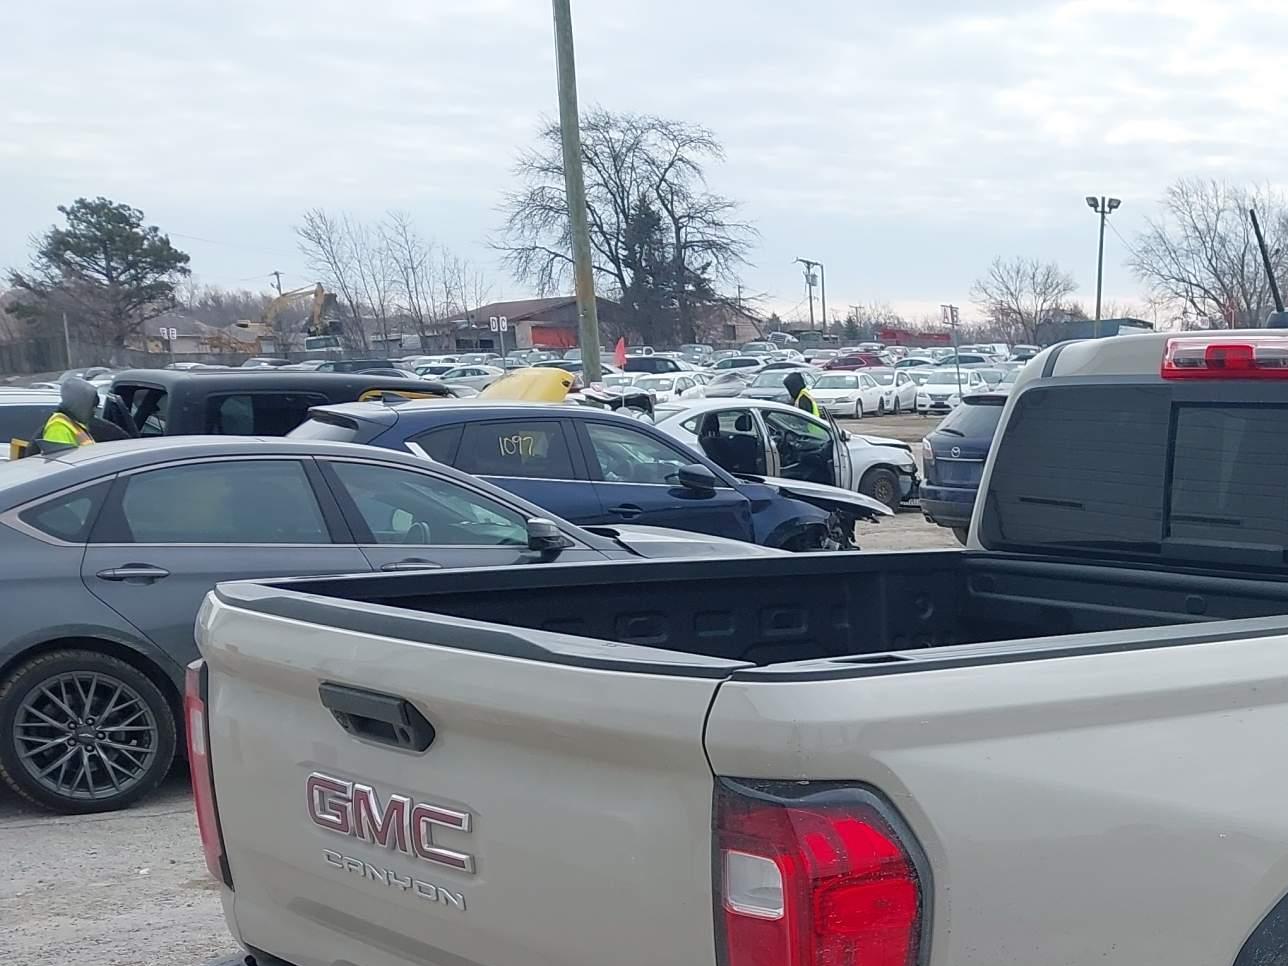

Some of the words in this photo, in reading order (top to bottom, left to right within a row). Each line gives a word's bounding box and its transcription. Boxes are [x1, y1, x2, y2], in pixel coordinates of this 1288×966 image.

[499, 435, 534, 456] 1097
[307, 772, 475, 873] GMC
[323, 849, 466, 910] CANYON
